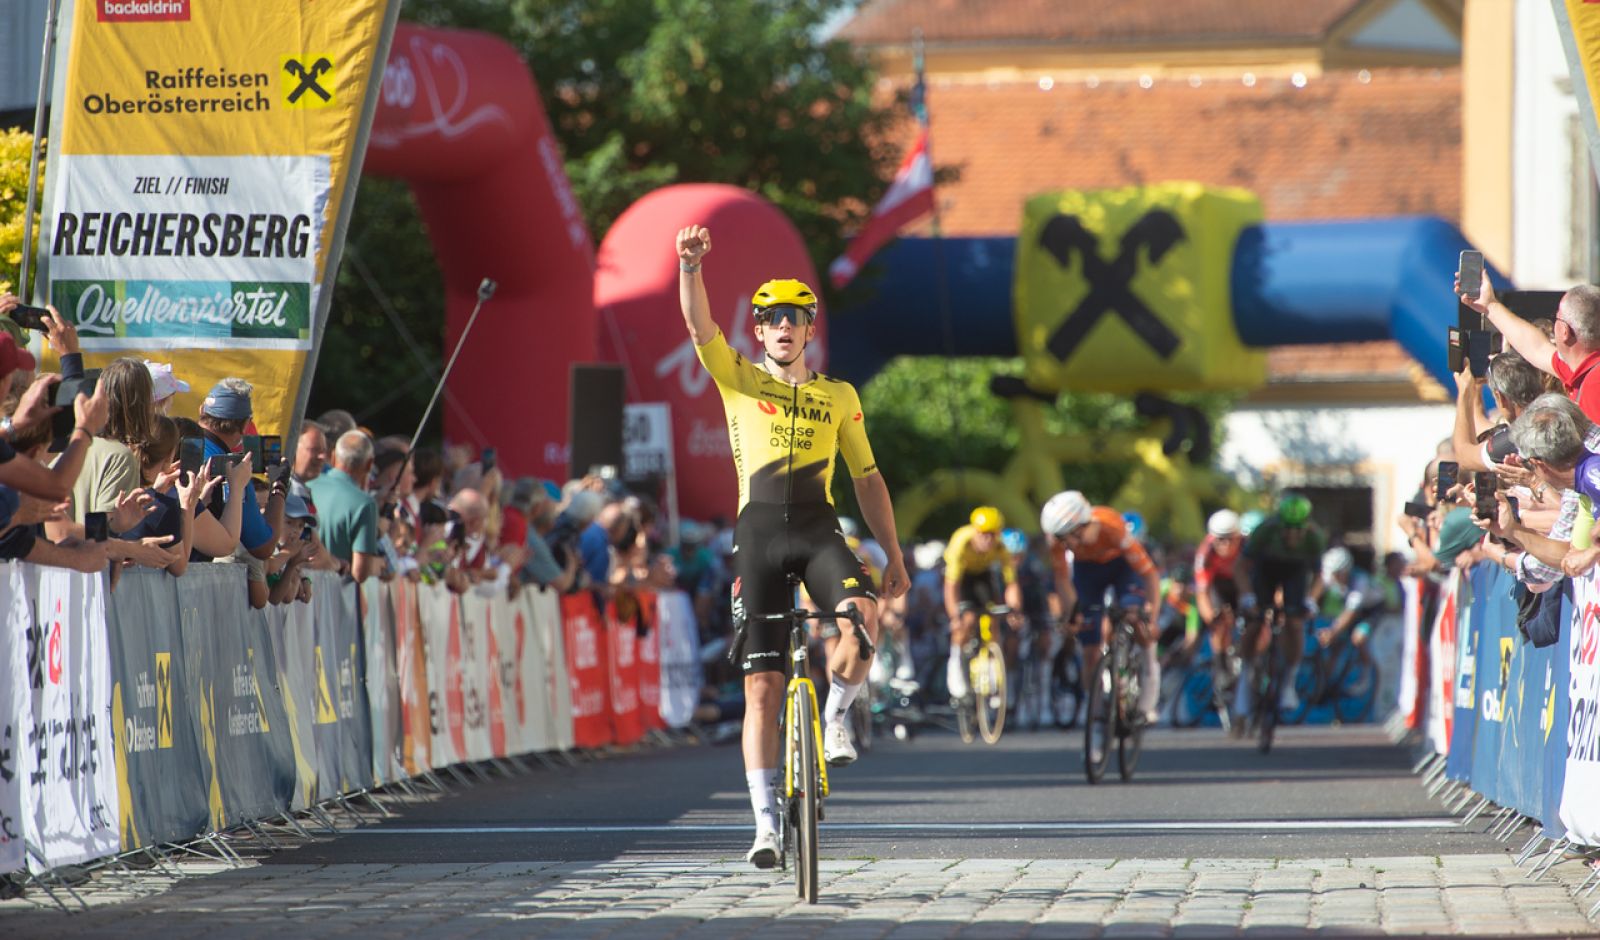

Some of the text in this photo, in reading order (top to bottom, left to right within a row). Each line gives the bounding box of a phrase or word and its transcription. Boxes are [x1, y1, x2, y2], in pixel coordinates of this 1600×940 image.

[104, 0, 182, 14] backaldrin
[145, 67, 269, 89] Raiffeisen
[83, 91, 270, 114] Oberösterreich
[133, 176, 161, 194] ZIEL
[184, 177, 229, 195] FINISH
[53, 212, 311, 258] REICHERSBERG
[75, 283, 289, 335] Quellenviertel
[783, 404, 832, 425] VISMA
[770, 421, 815, 438] lease
